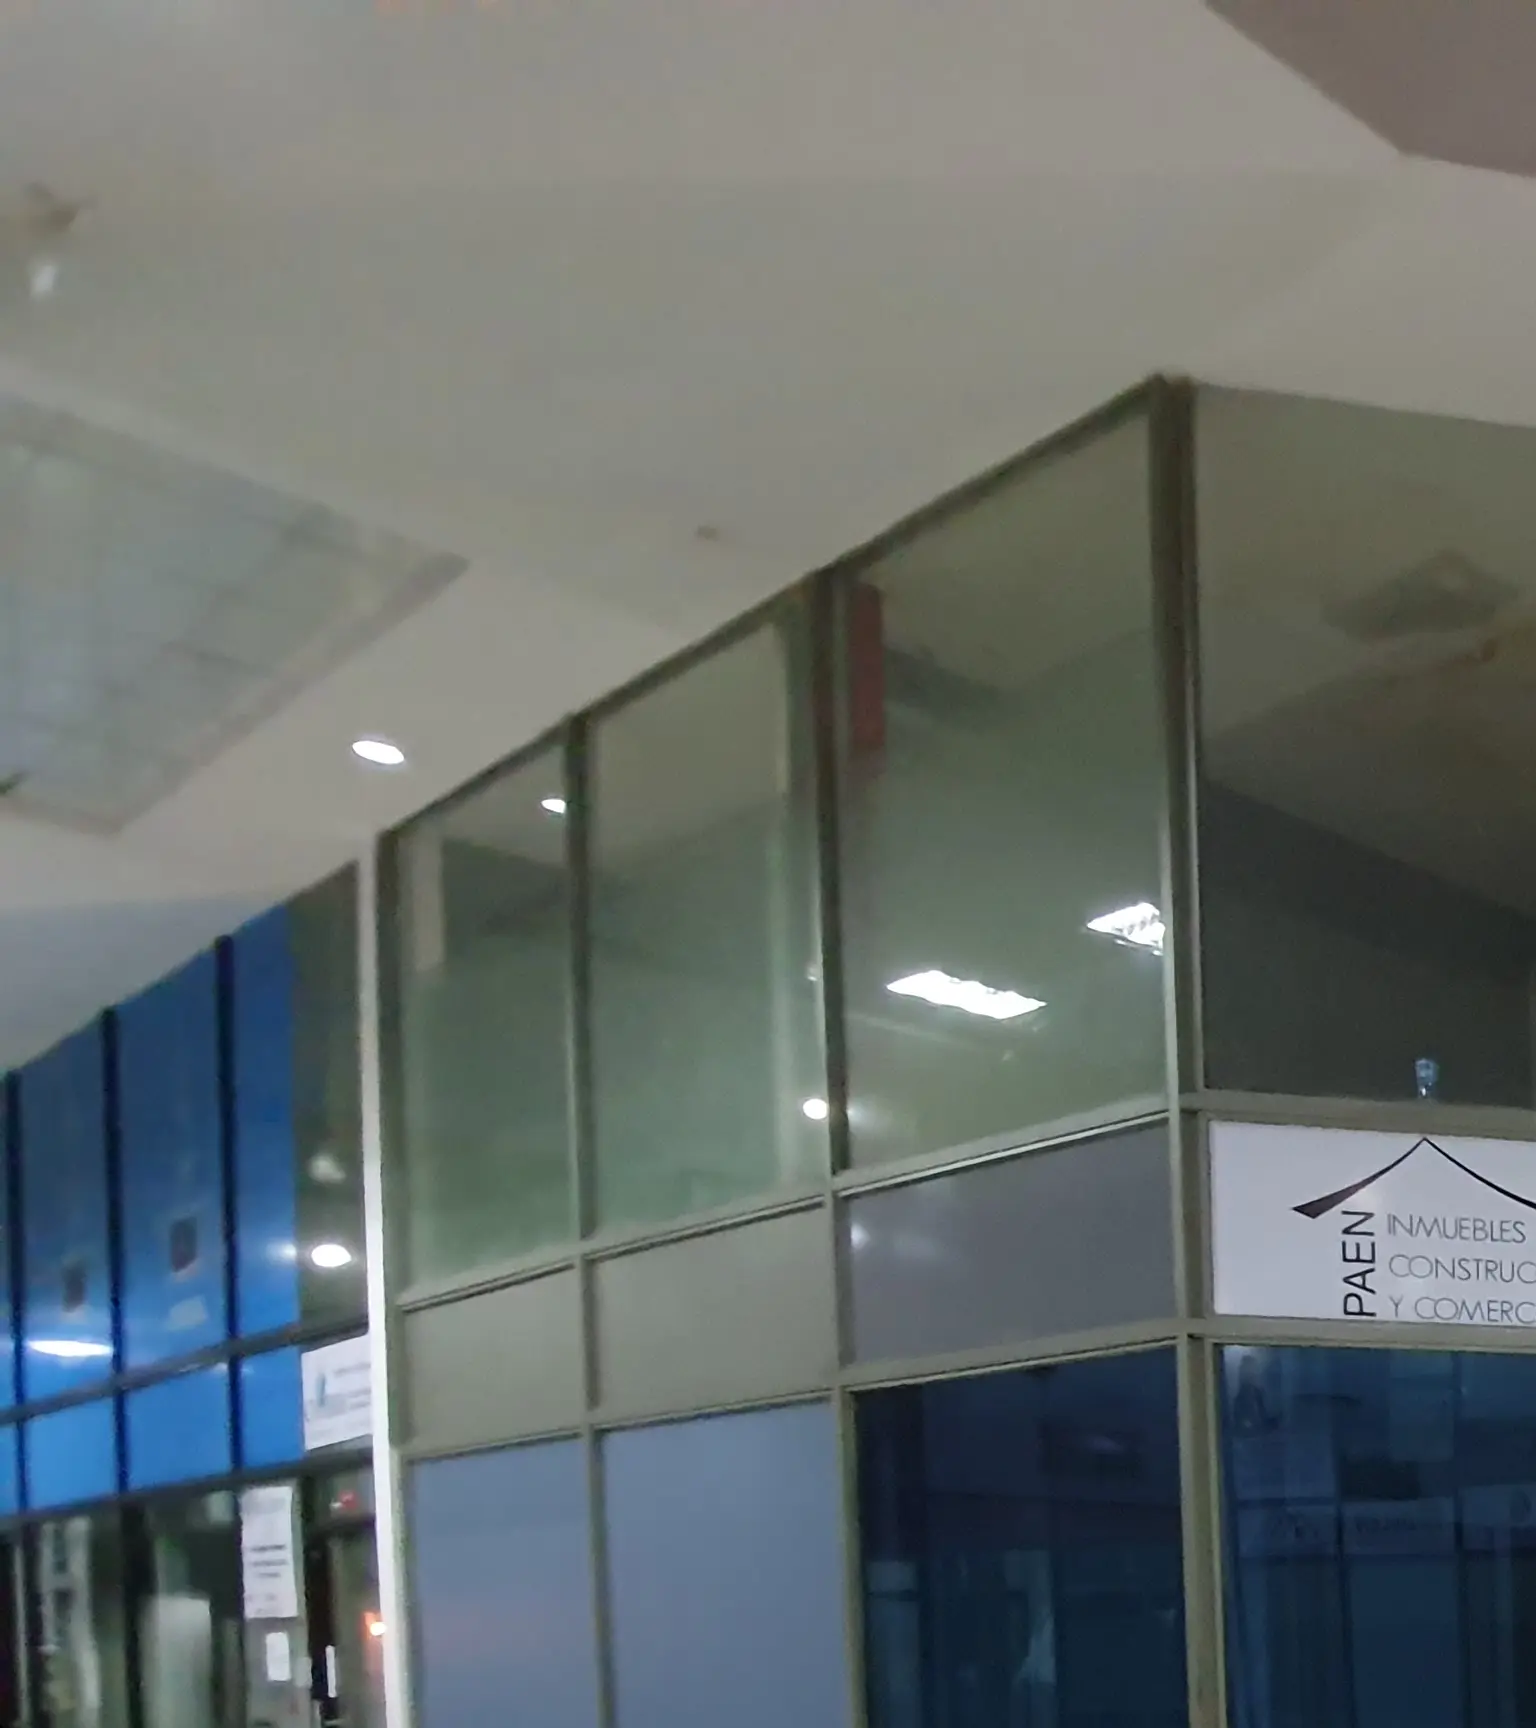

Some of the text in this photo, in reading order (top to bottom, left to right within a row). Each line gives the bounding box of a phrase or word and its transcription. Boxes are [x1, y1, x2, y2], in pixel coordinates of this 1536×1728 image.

[1387, 1213, 1527, 1244] INMUEBLES
[1342, 1209, 1377, 1318] PAEN
[1389, 1295, 1403, 1318] Y
